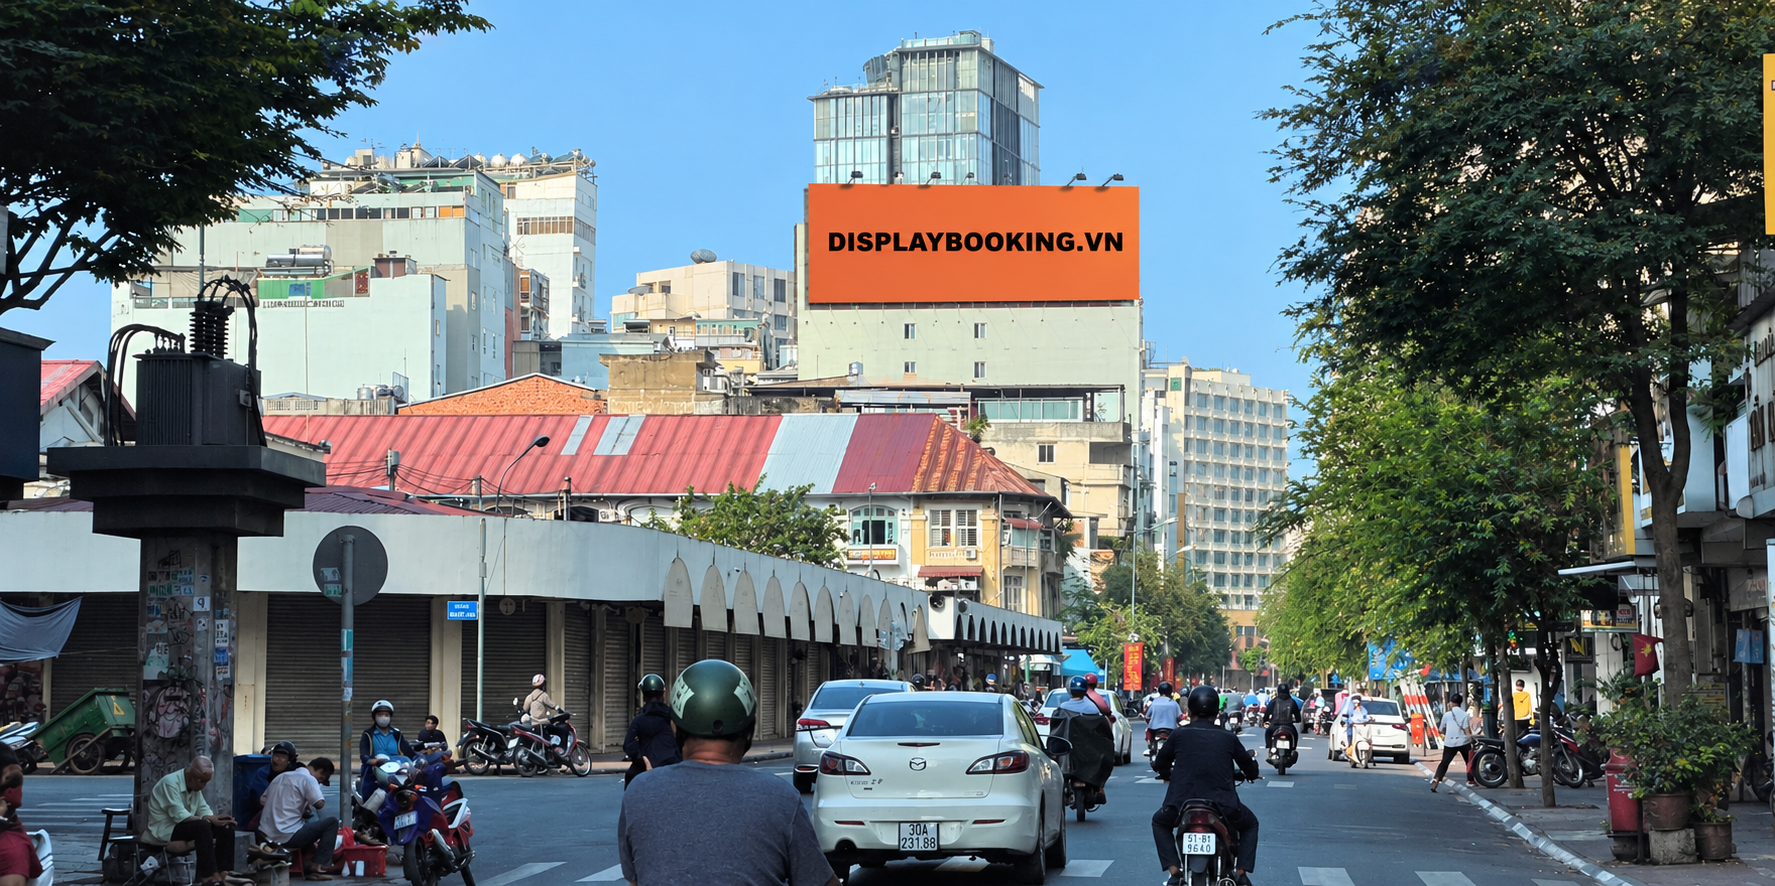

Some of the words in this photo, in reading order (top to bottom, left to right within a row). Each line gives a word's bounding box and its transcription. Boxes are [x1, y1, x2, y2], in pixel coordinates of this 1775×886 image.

[828, 231, 1123, 252] DISPLAYBOOKING.VN
[908, 823, 928, 836] 30A
[901, 837, 936, 849] 231.88
[1187, 844, 1211, 853] 9640
